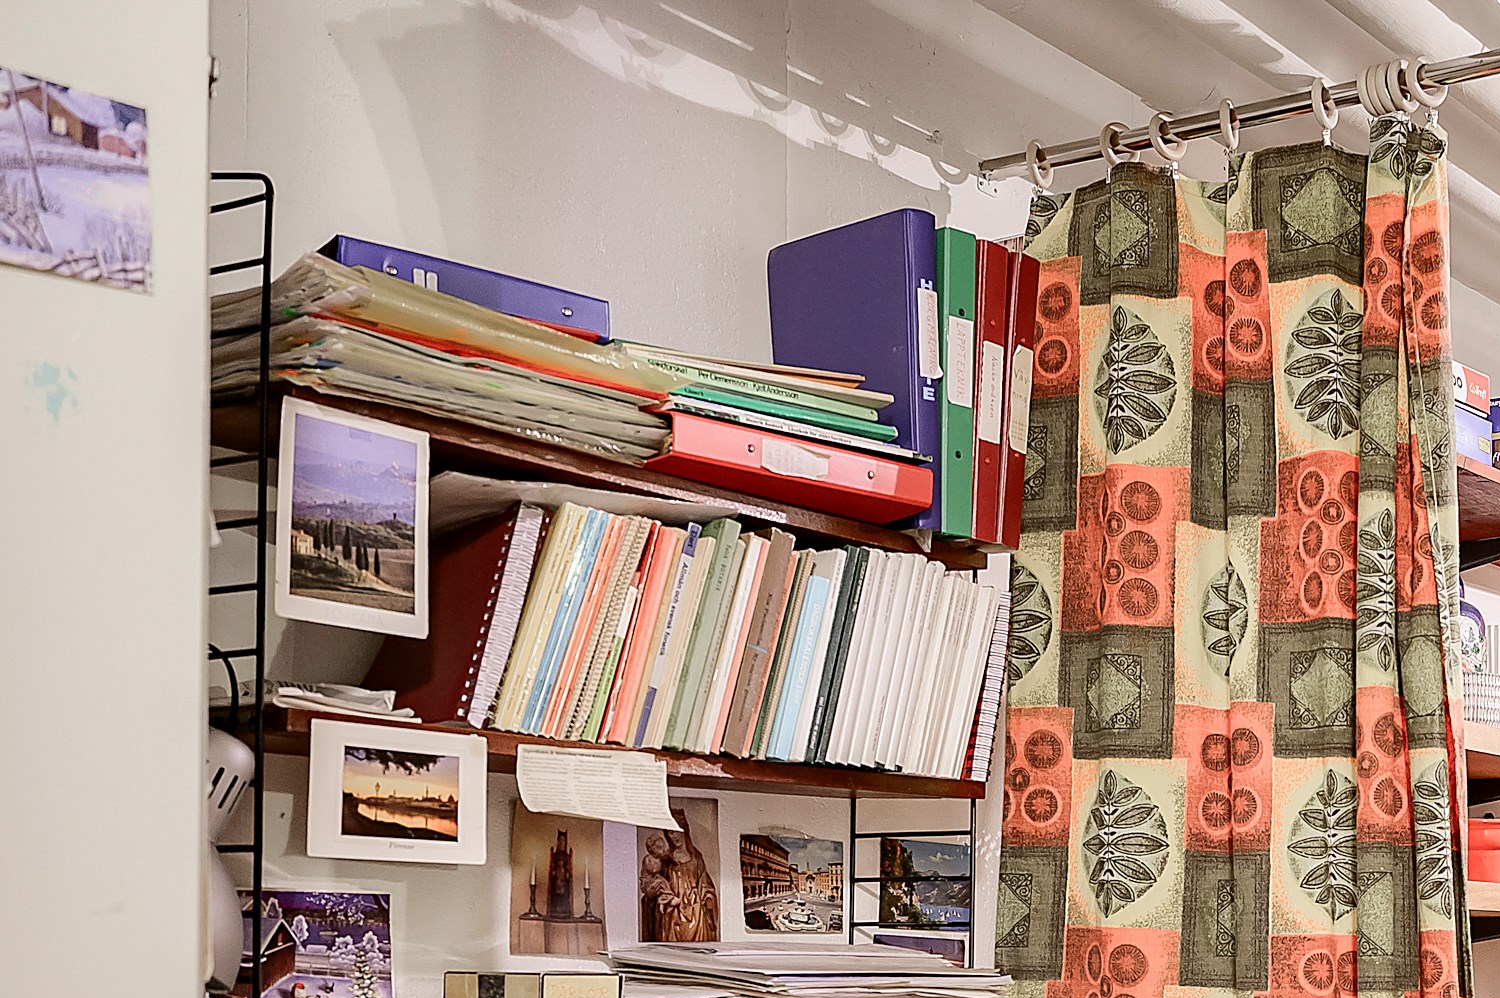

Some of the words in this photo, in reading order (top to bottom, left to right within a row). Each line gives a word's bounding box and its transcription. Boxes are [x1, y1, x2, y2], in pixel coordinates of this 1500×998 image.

[956, 322, 966, 400] LAPPTEKNIK
[699, 371, 709, 379] Per
[768, 385, 799, 398] Andersson
[677, 562, 689, 588] Allmän
[673, 589, 683, 604] och
[666, 605, 677, 630] svensk
[659, 631, 671, 657] fonetik
